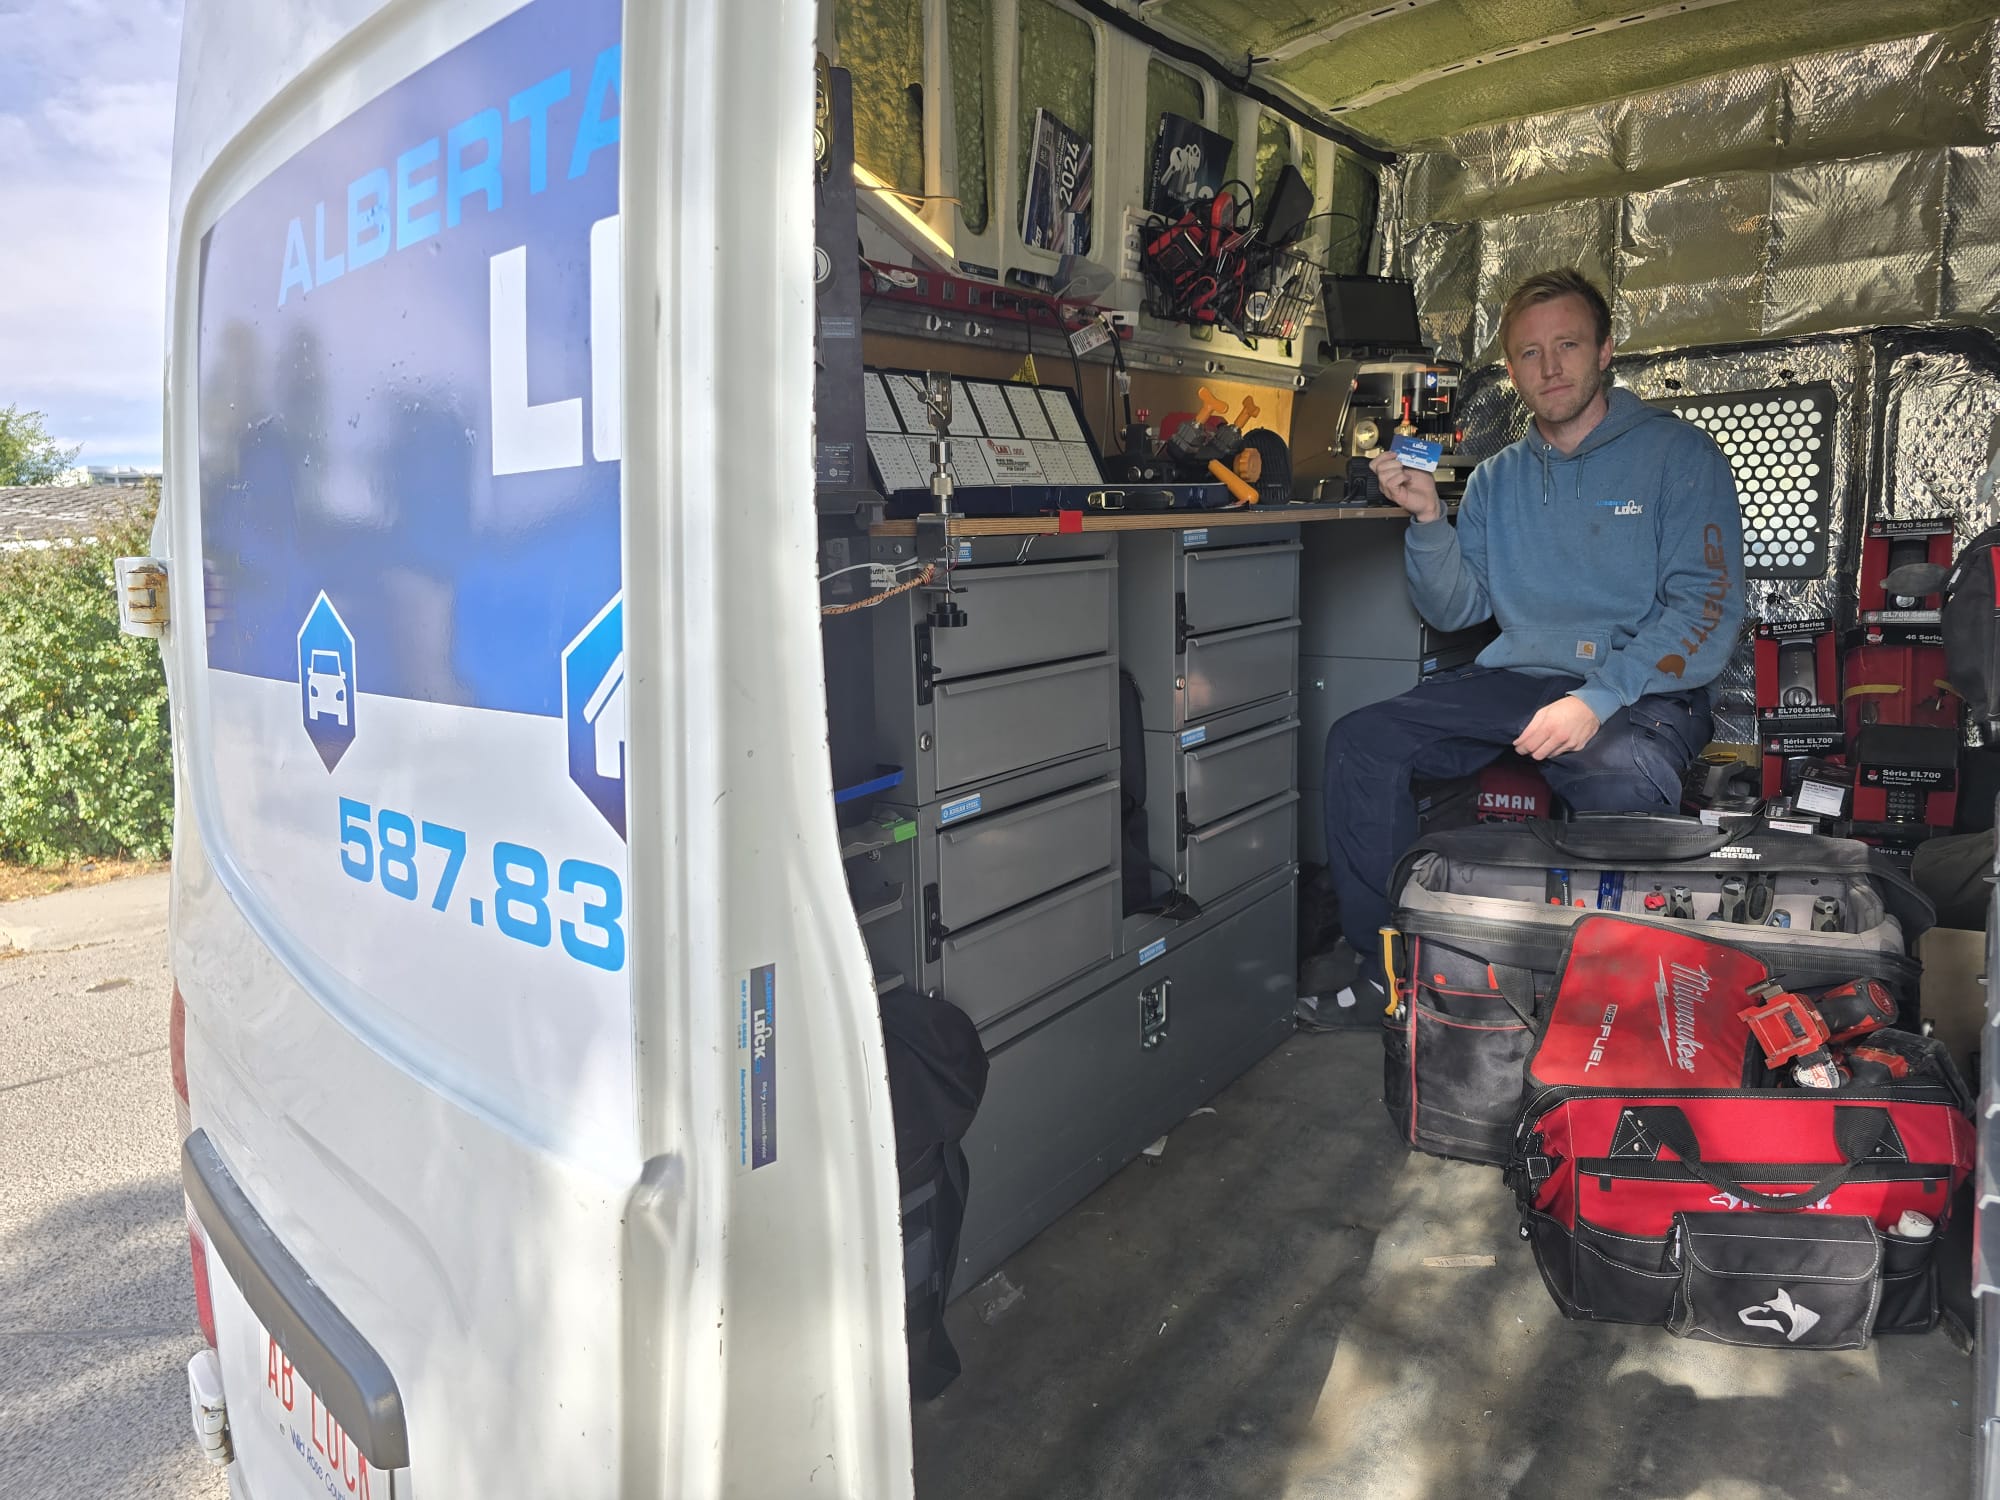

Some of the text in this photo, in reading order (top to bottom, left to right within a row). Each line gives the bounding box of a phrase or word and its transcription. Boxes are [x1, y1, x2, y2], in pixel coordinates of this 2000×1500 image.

[277, 44, 620, 308] ALBERTA
[1059, 143, 1080, 206] 2024
[1615, 500, 1643, 515] LOCK
[1887, 520, 1944, 530] EL700 Series
[1681, 523, 1732, 656] carhartt
[1773, 623, 1797, 631] EL700
[1882, 769, 1941, 779] Série EL700
[1710, 852, 1762, 860] RESISTANT
[1720, 846, 1753, 854] WATER
[338, 796, 625, 972] 587.83
[754, 1008, 769, 1060] LOCK
[1584, 1004, 1618, 1072] M12 FUEL
[1671, 962, 1712, 1072] Milwaukee
[268, 1334, 294, 1412] AB
